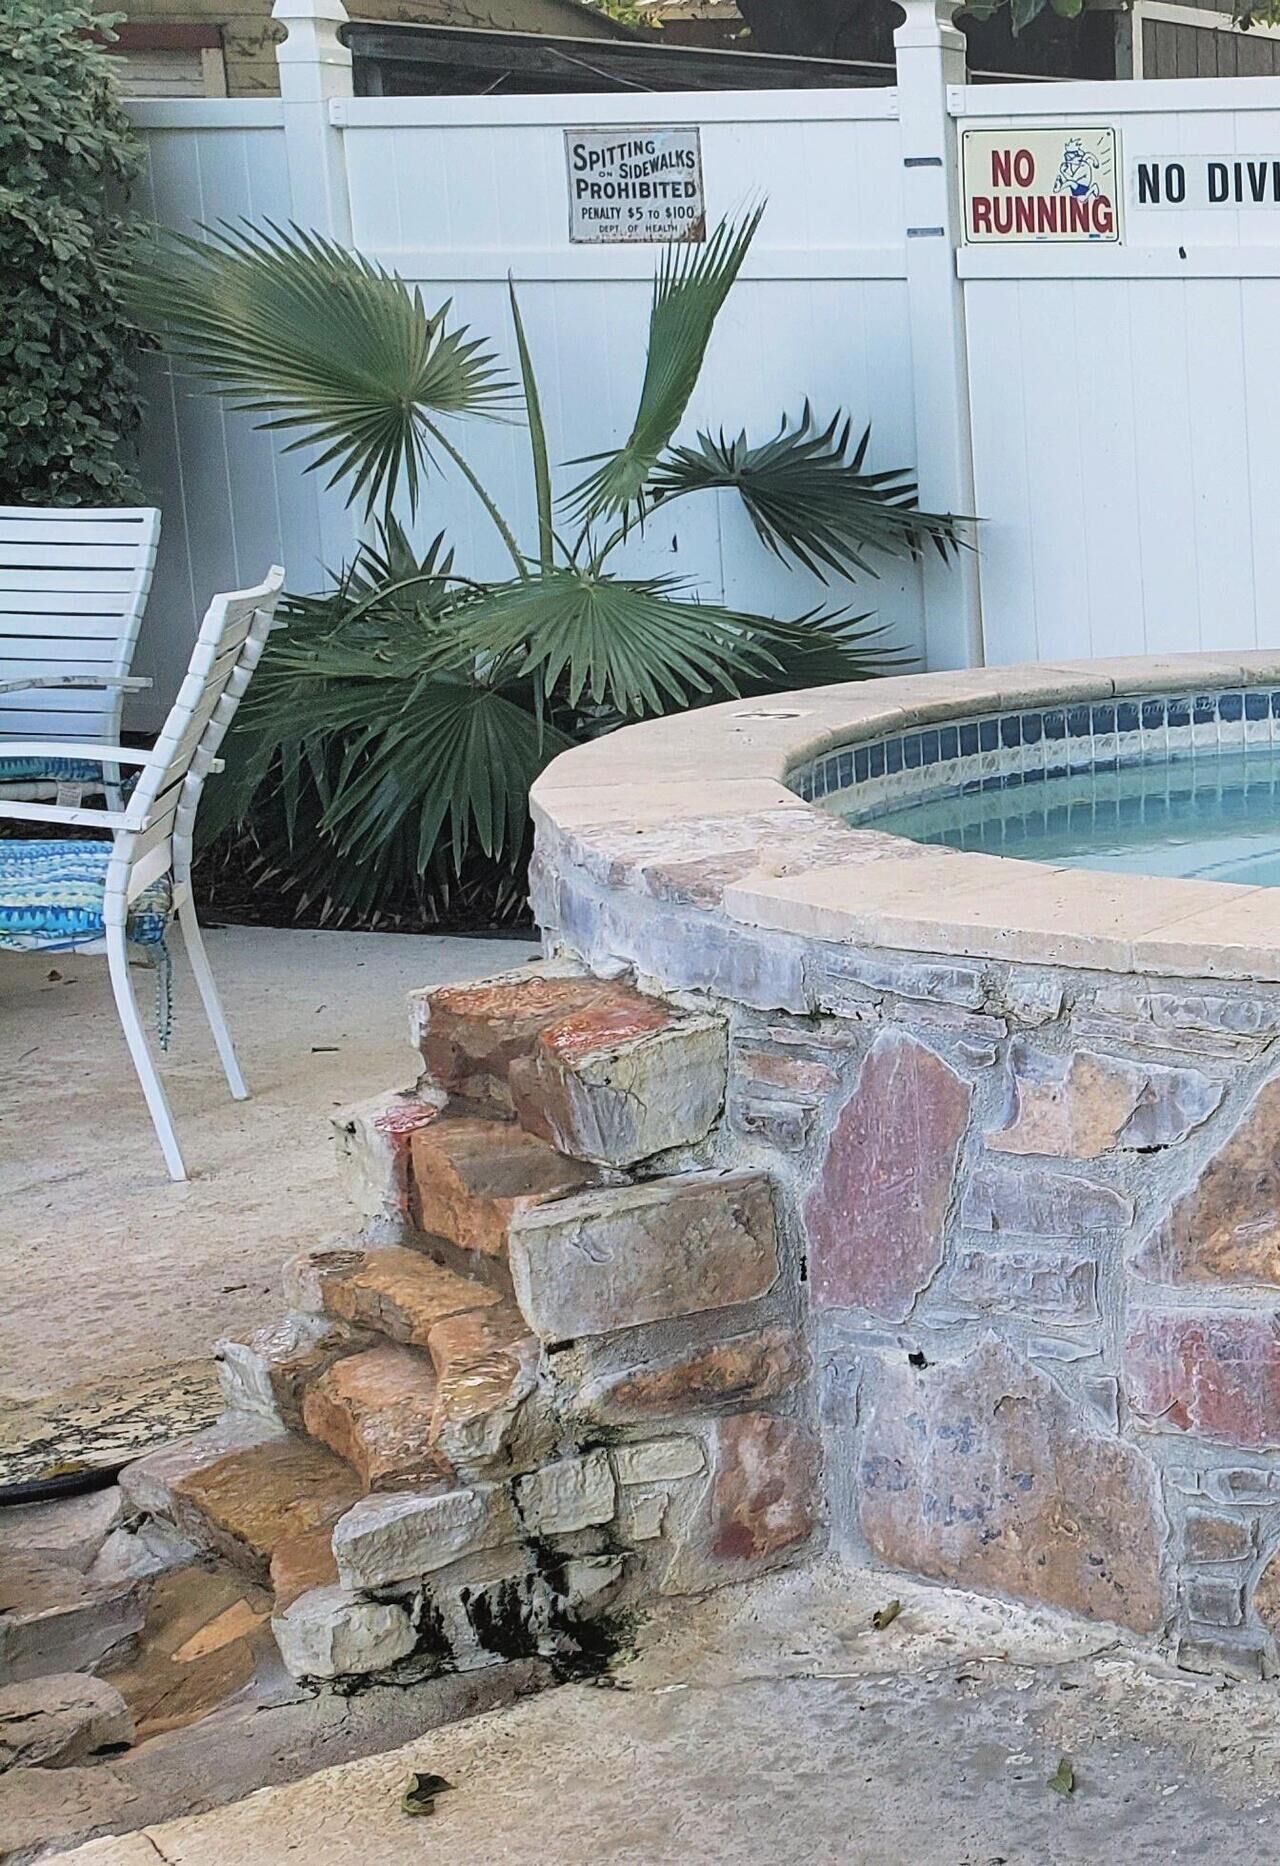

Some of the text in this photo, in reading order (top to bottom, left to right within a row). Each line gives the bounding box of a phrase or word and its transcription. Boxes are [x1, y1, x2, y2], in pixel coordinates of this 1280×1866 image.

[573, 141, 655, 171] SPITTING
[619, 150, 696, 179] SIDEWALKS
[991, 149, 1035, 188] NO
[576, 179, 697, 199] PROHIBITED
[1137, 162, 1186, 204] NO
[582, 206, 694, 220] PENALTY $5 TO $100
[972, 196, 1113, 235] RUNNING
[645, 224, 678, 232] HEALTH
